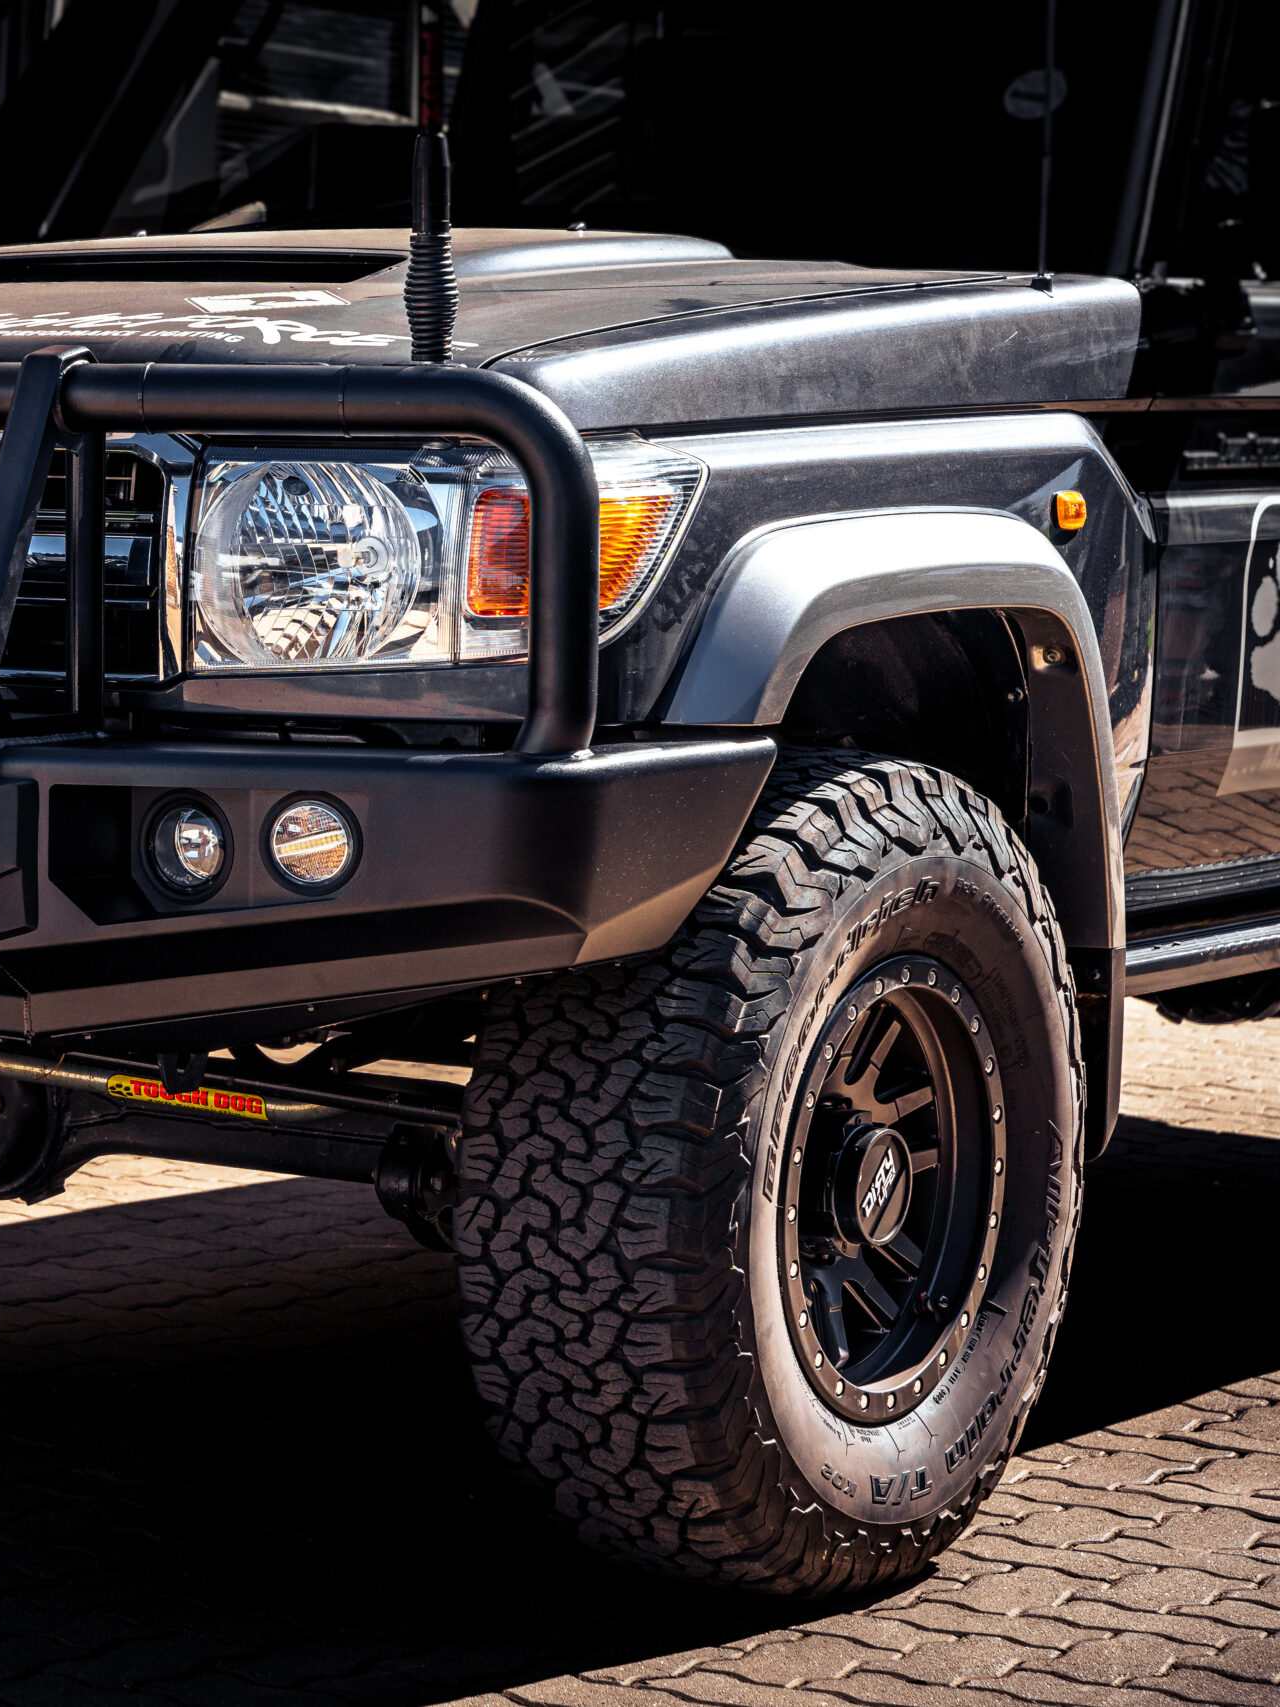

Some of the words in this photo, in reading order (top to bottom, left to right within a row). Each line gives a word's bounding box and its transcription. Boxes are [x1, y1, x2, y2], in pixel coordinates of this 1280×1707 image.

[140, 329, 245, 343] LIGHTING
[762, 874, 942, 1204] BFGoodrich
[213, 1093, 262, 1114] DOG
[943, 1119, 1064, 1475] All-Terrain
[869, 1465, 934, 1506] T/A
